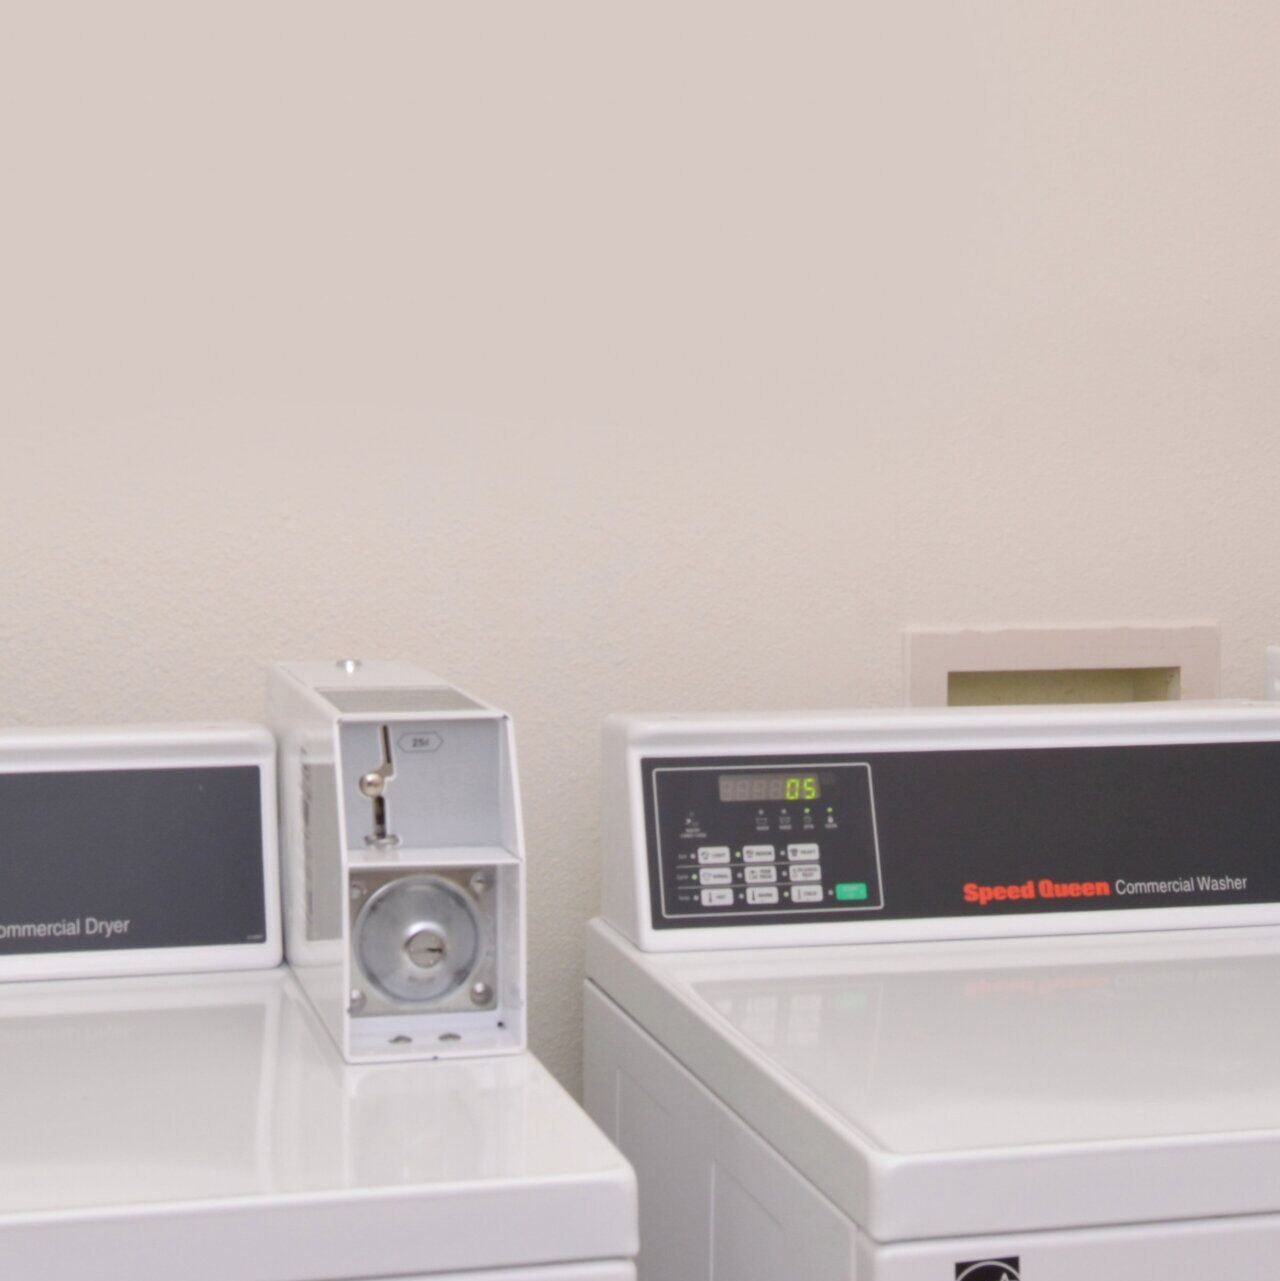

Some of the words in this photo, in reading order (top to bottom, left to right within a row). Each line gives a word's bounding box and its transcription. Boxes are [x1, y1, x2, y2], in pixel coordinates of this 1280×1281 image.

[963, 880, 1035, 905] Speed
[1038, 878, 1110, 898] Queen
[1115, 876, 1195, 896] Commercial
[1197, 875, 1248, 891] Washer
[85, 916, 131, 939] Dryer
